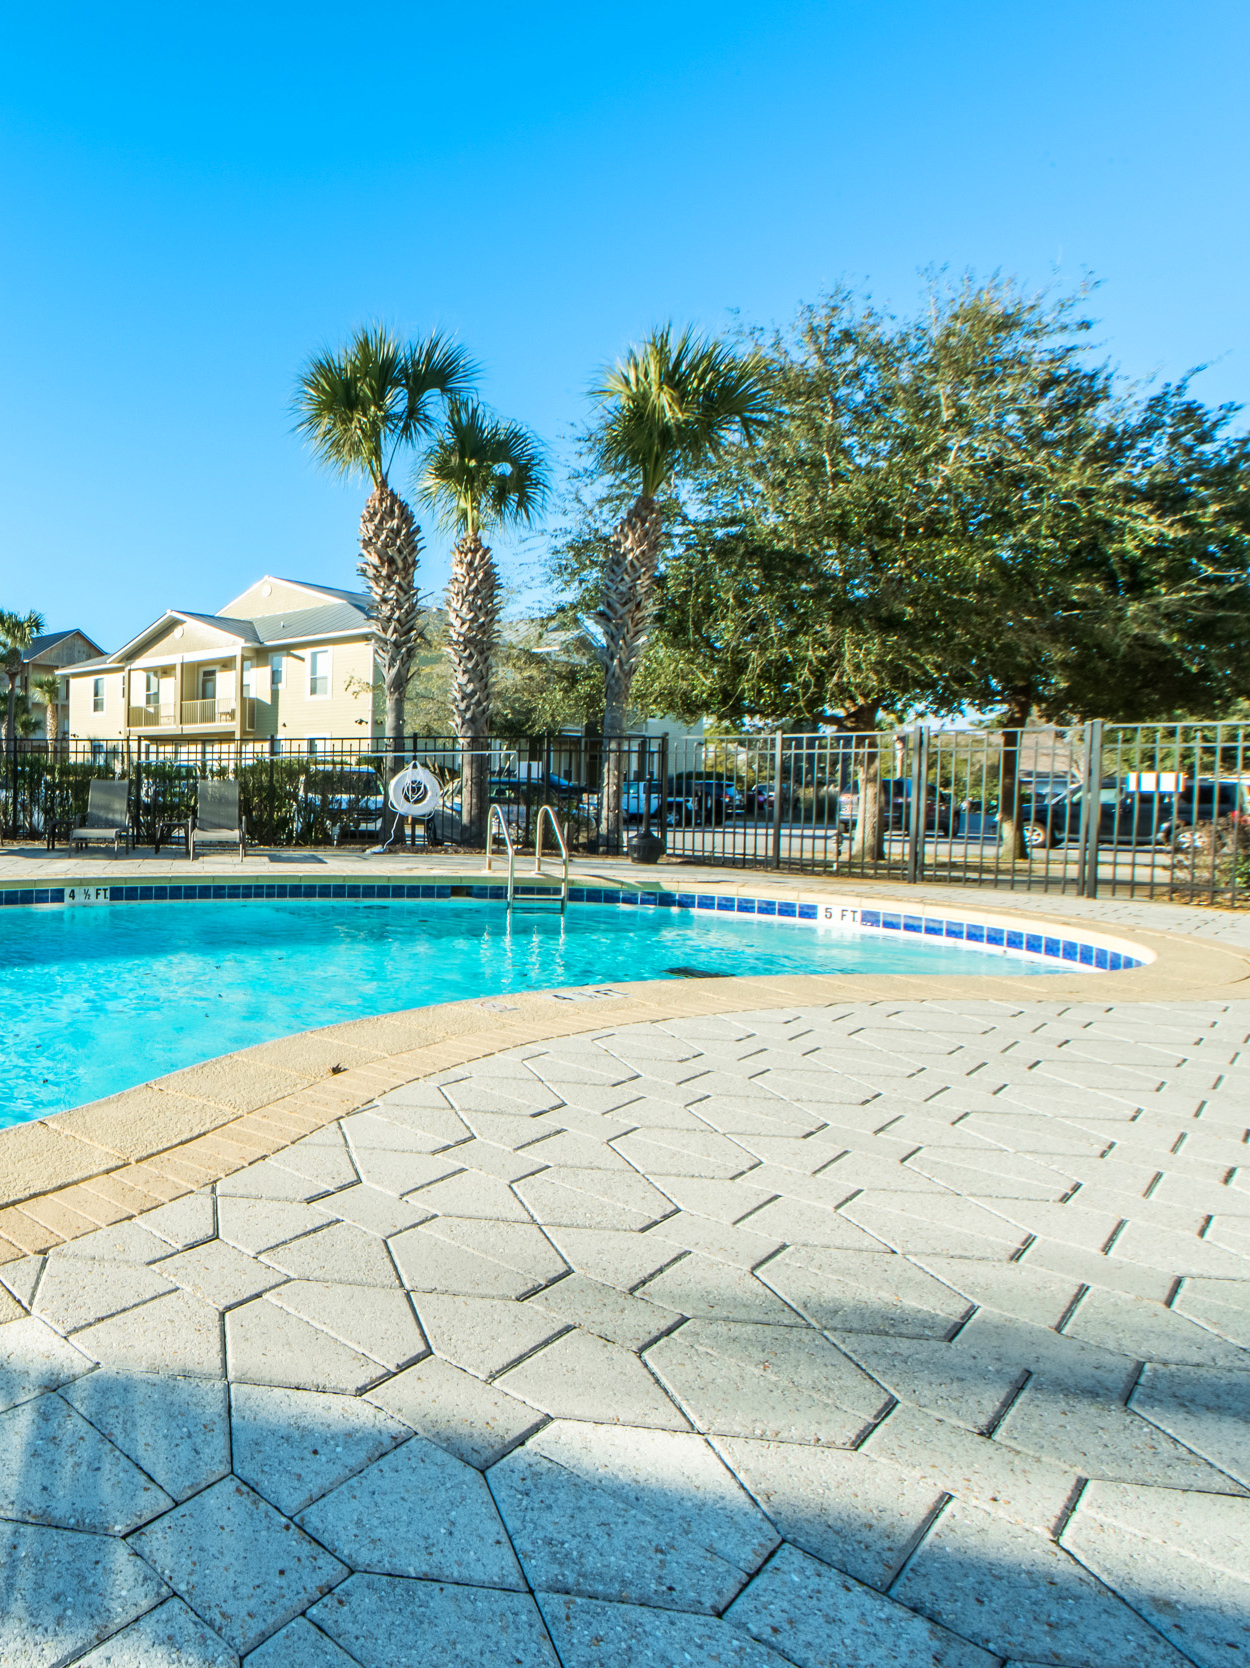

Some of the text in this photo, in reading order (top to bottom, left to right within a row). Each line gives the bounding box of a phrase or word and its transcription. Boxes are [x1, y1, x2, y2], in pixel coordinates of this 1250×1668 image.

[69, 888, 75, 900] 4
[95, 888, 108, 900] FT.
[824, 907, 833, 920] 5
